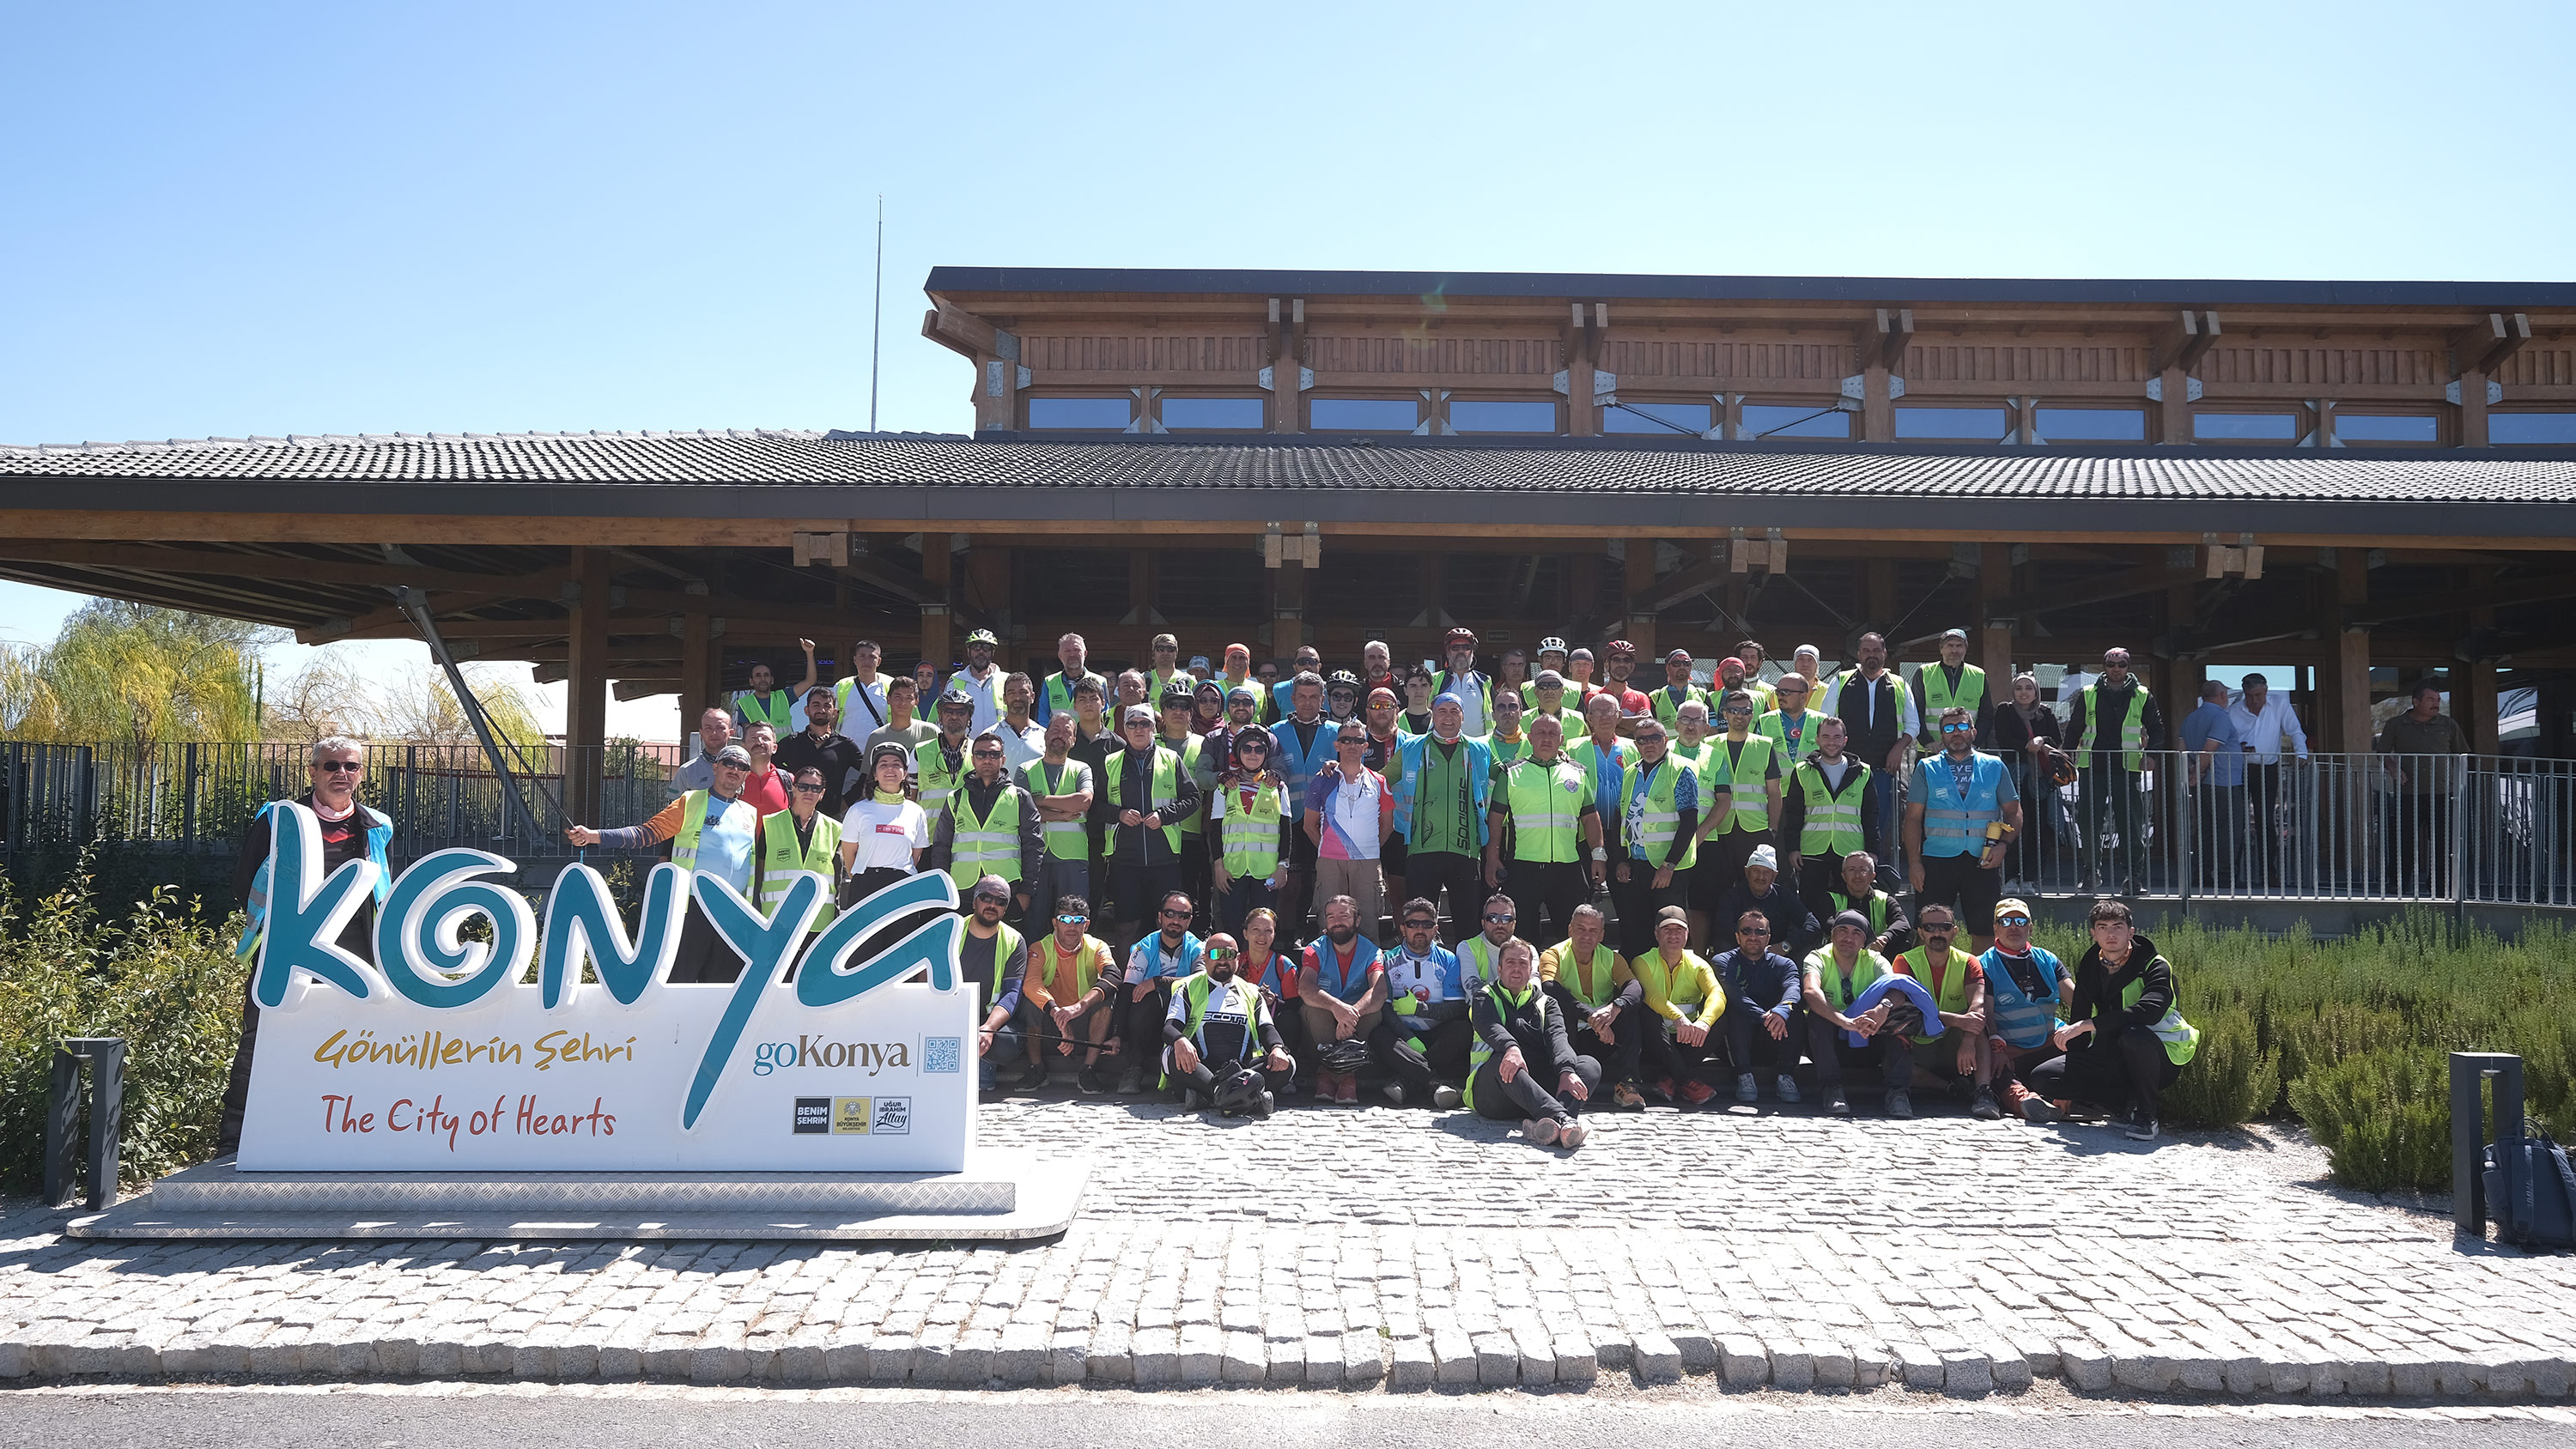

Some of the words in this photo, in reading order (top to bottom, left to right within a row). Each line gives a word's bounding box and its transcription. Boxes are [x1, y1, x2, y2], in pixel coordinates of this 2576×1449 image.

[1948, 764, 1972, 773] EVE
[1201, 1011, 1249, 1025] SCOTT
[313, 1028, 522, 1070] Gönüllerin
[533, 1029, 637, 1071] Şehri
[752, 1034, 912, 1076] goKonya
[797, 1106, 828, 1115] BENİM
[321, 1094, 375, 1134] The
[387, 1094, 460, 1153] City
[469, 1094, 507, 1136] of
[516, 1094, 617, 1137] Hearts
[796, 1117, 827, 1126] ŞEHRİM
